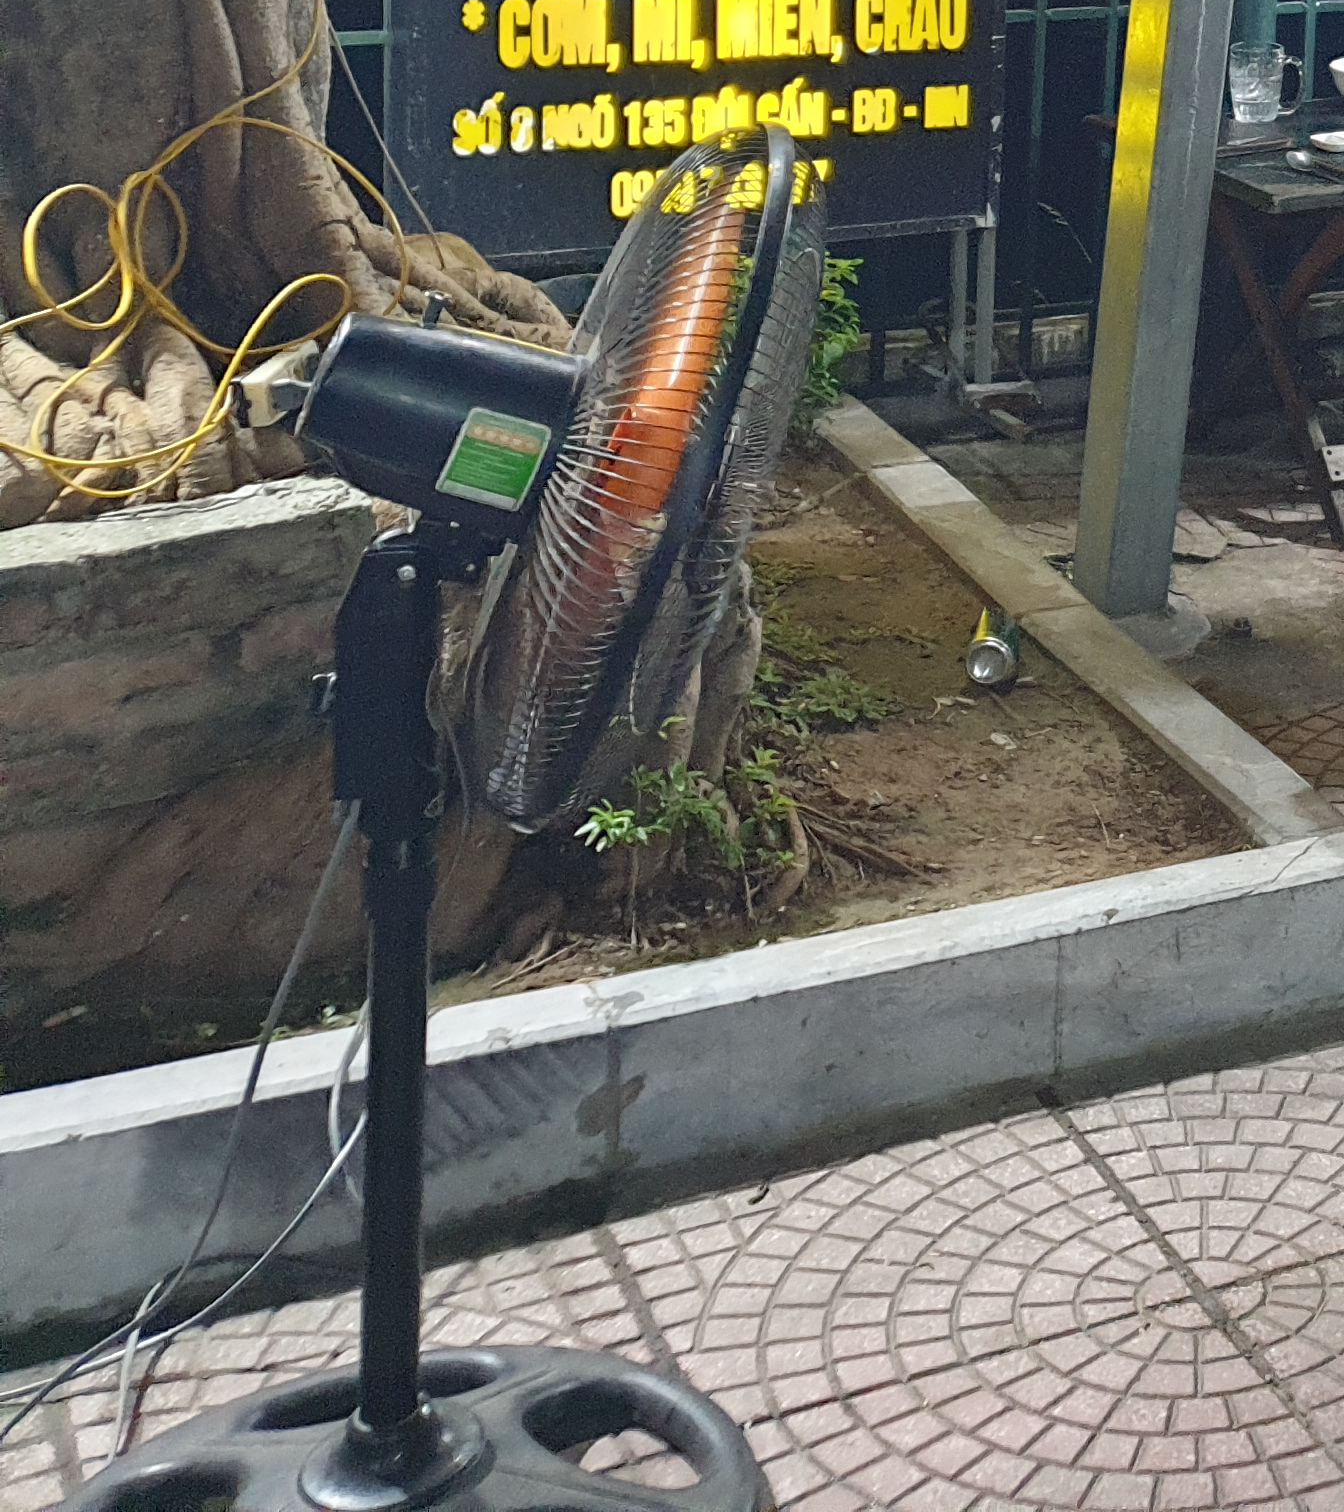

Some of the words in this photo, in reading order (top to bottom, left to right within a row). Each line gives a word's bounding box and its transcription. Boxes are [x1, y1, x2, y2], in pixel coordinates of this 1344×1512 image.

[452, 91, 505, 156] SỐ
[510, 106, 534, 153] 8
[623, 98, 685, 146] 135
